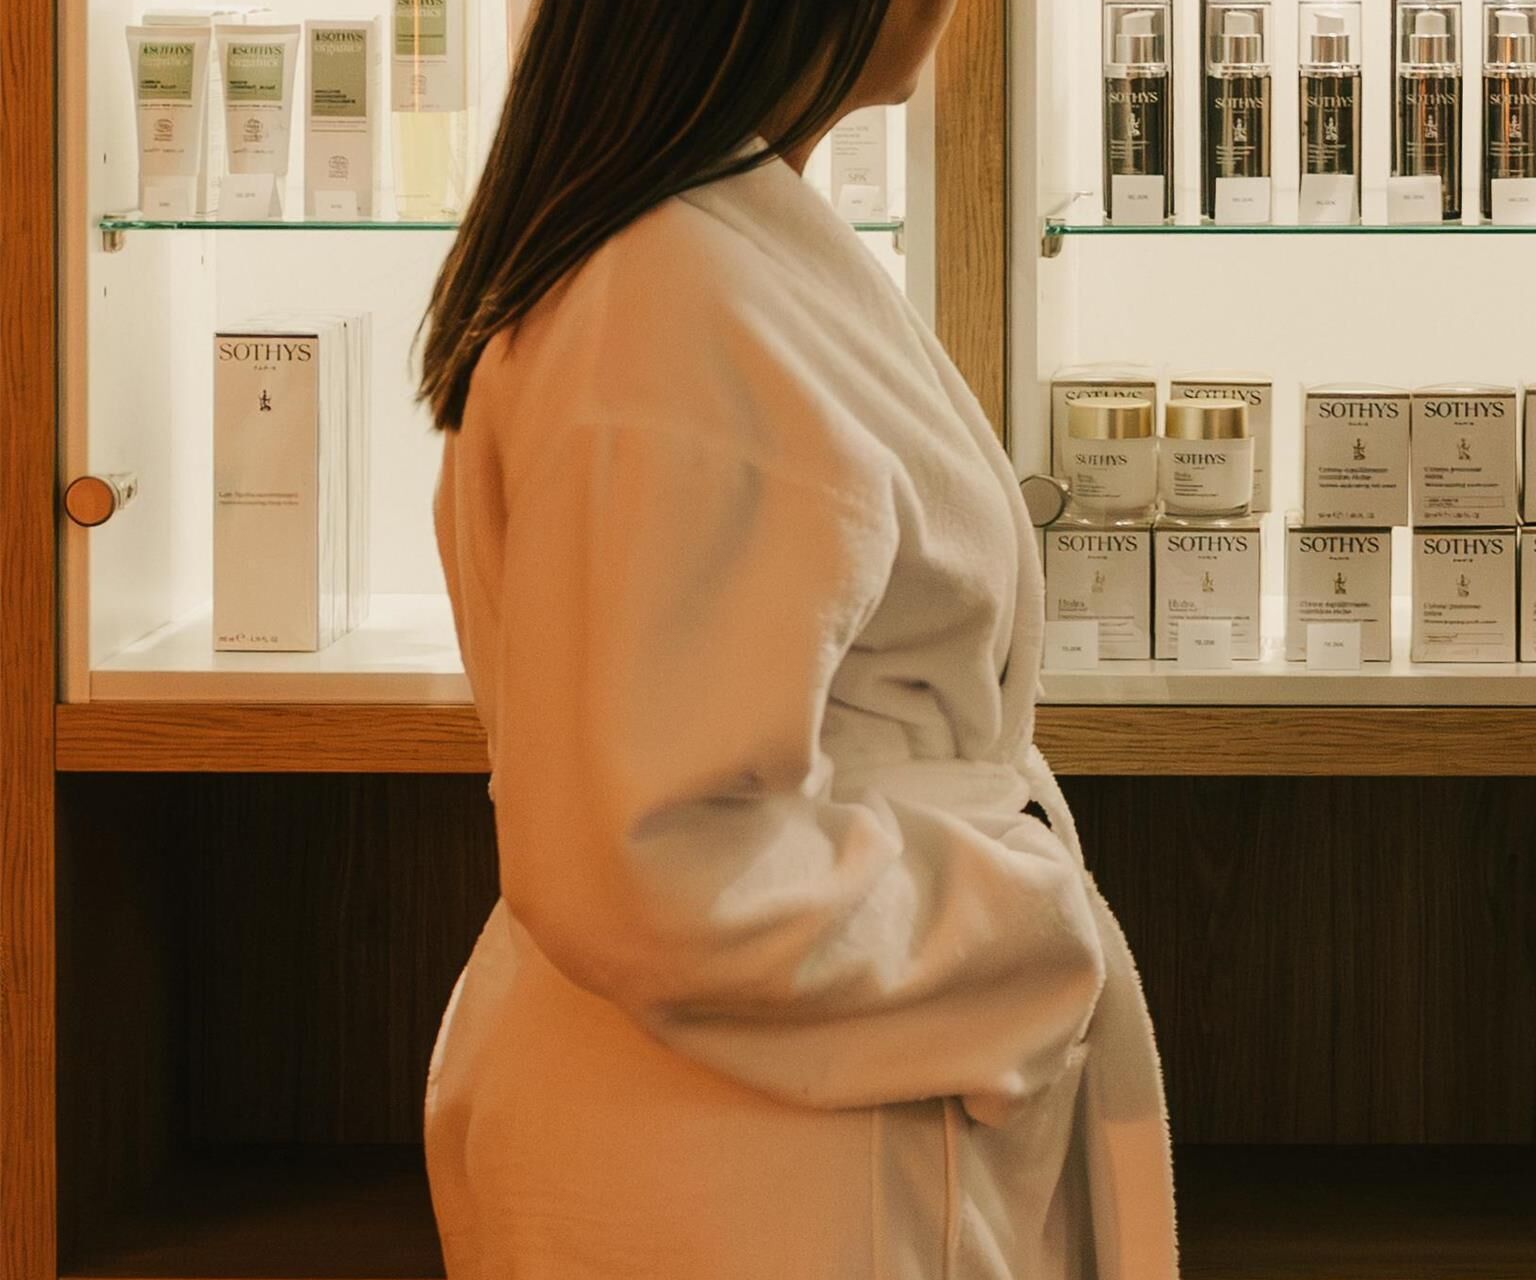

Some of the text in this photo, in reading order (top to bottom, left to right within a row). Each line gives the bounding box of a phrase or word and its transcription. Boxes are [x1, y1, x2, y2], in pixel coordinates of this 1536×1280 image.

[1109, 92, 1159, 104] SOTHYS
[1215, 97, 1264, 109] SOTHYS
[1306, 96, 1355, 108] SOTHYS
[1406, 94, 1456, 106] SOTHYS
[218, 342, 312, 361] SOTHYS
[1319, 402, 1399, 418] SOTHYS
[1424, 401, 1505, 418] SOTHYS
[1075, 453, 1128, 466] SOTHYS
[1174, 453, 1227, 465] SOTHYS
[1057, 535, 1138, 553] SOTHYS
[1167, 535, 1248, 553] SOTHYS
[1300, 536, 1380, 553] SOTHYS
[1424, 538, 1504, 555] SOTHYS
